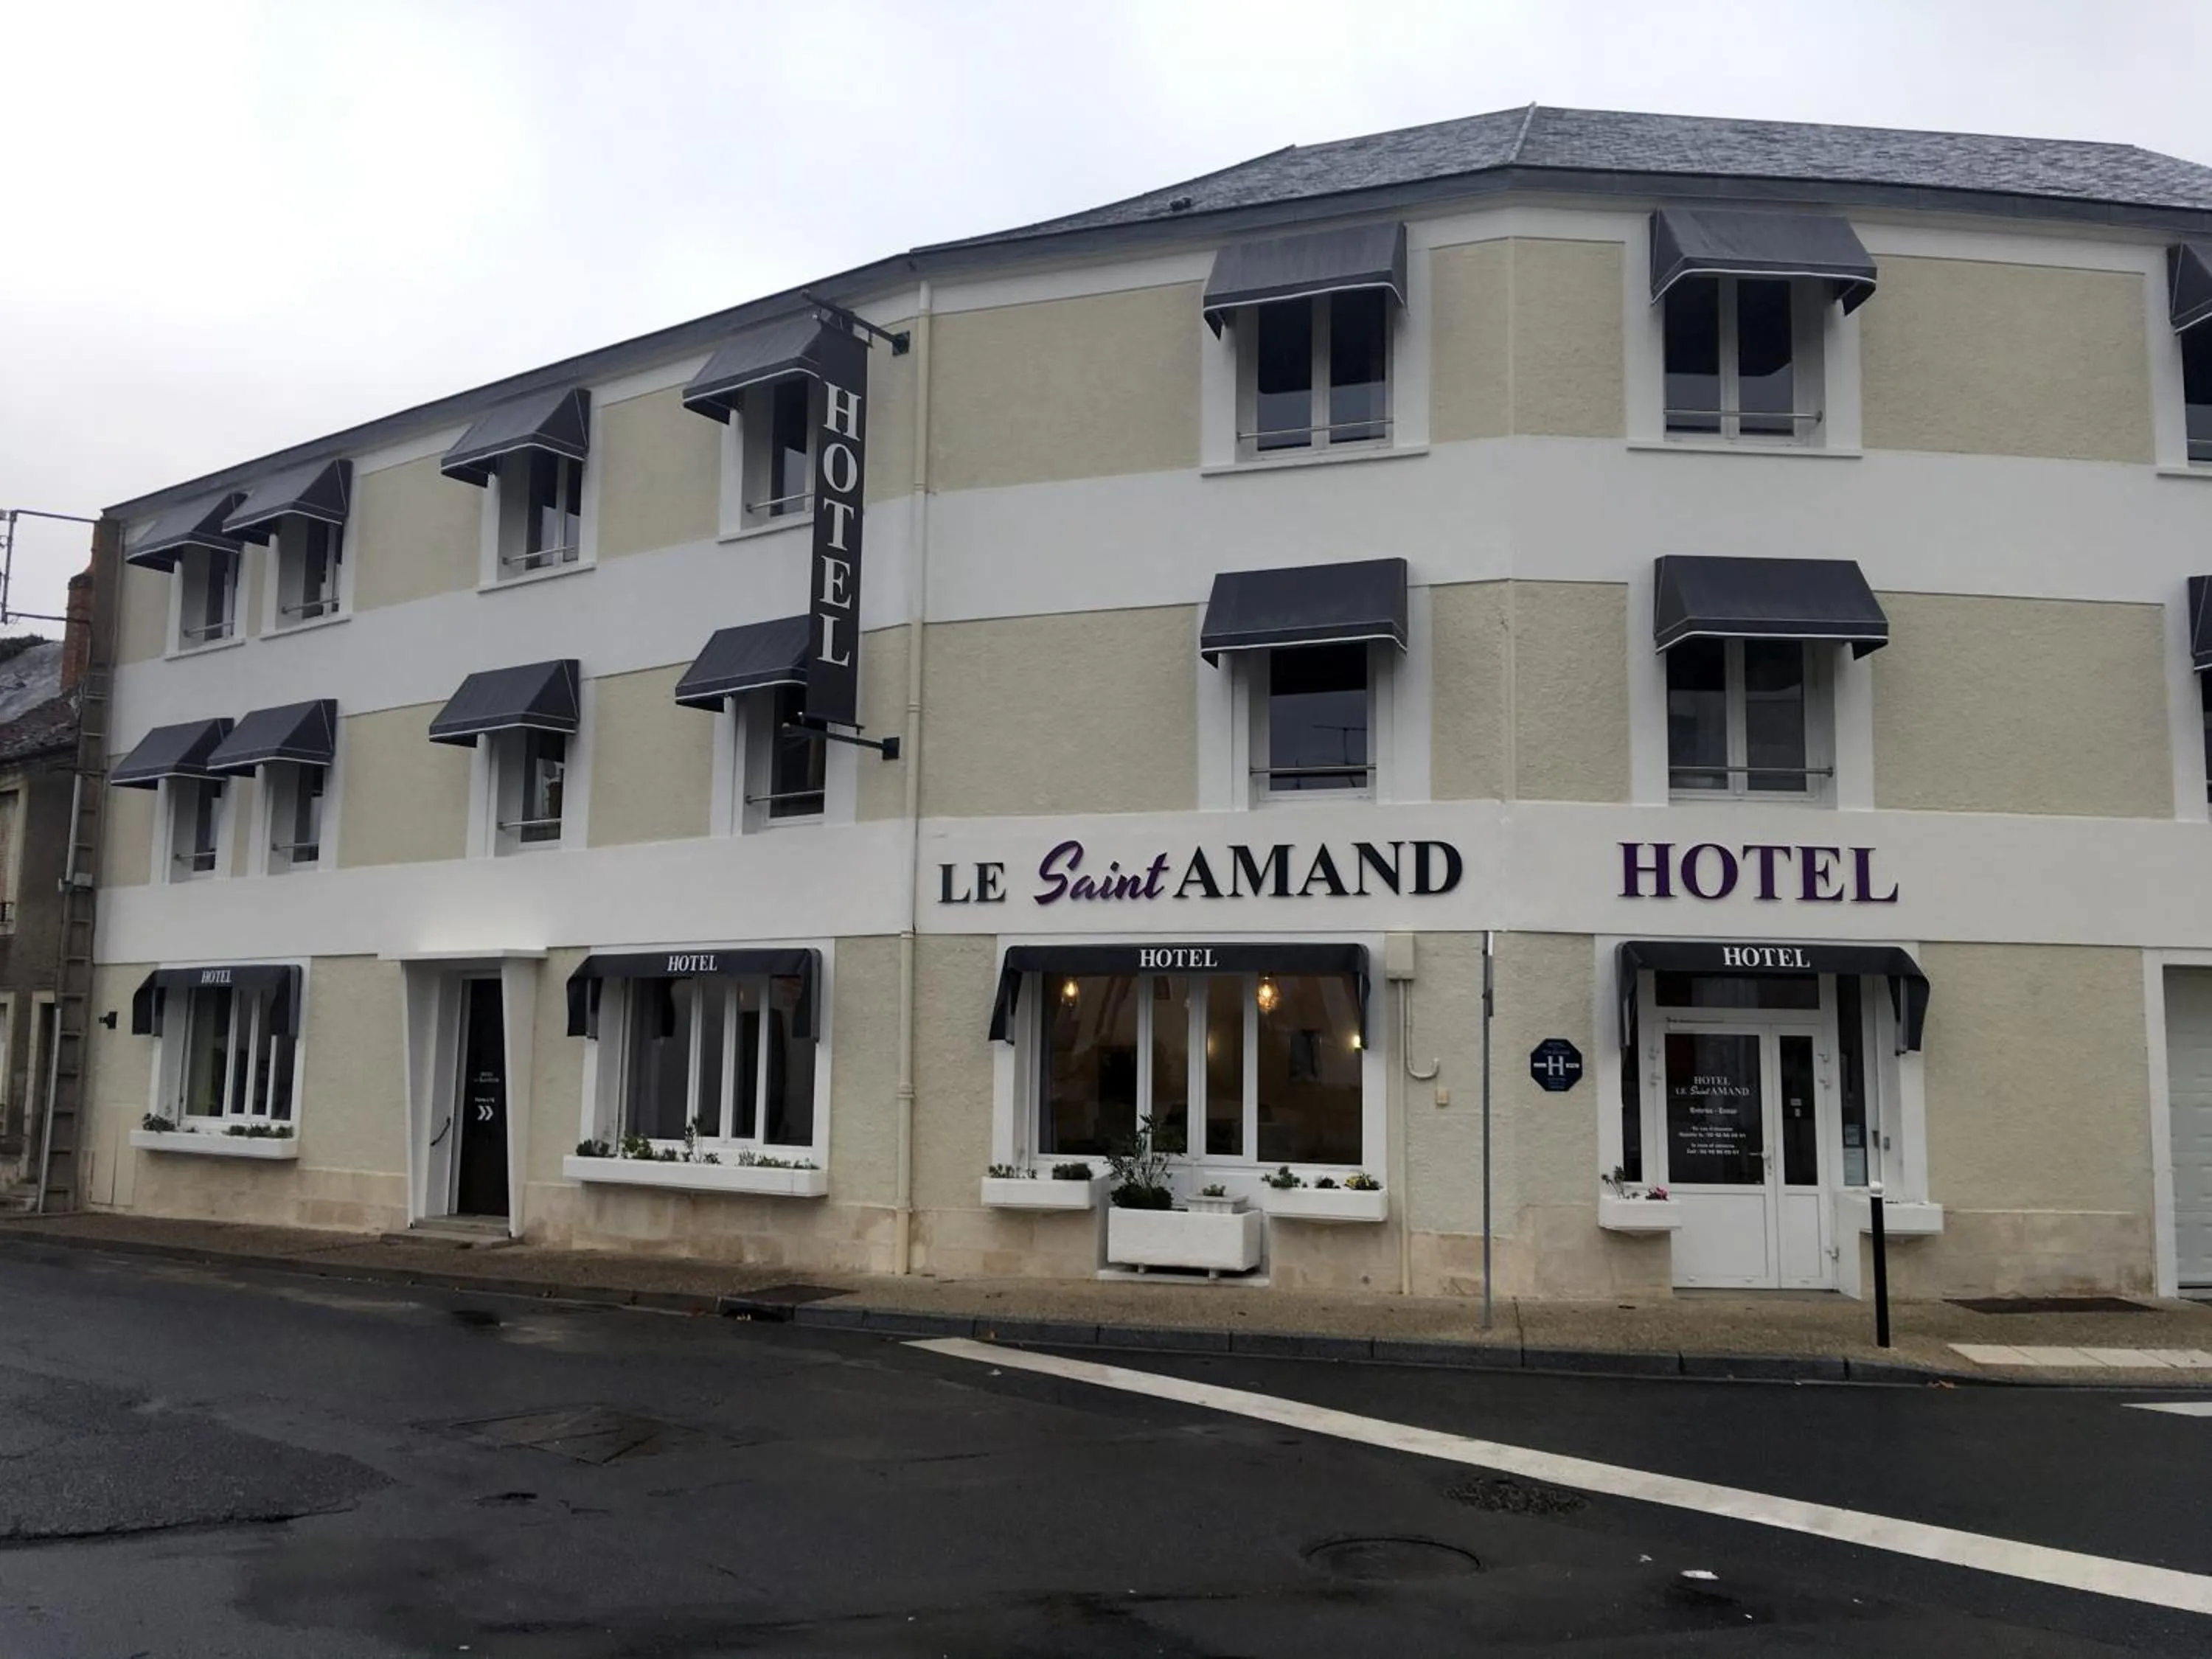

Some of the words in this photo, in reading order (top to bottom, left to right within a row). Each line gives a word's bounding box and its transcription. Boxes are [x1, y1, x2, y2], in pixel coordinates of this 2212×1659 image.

[816, 381, 862, 667] HOTEL
[937, 861, 1006, 903] LE
[1034, 839, 1171, 905] Saint
[1172, 839, 1464, 899] AMAND
[1617, 842, 1899, 902] HOTEL
[667, 955, 718, 972] HOTEL
[1139, 948, 1218, 967] HOTEL
[1722, 946, 1811, 968] HOTEL
[201, 970, 232, 984] HOTEL
[1547, 1055, 1565, 1077] H
